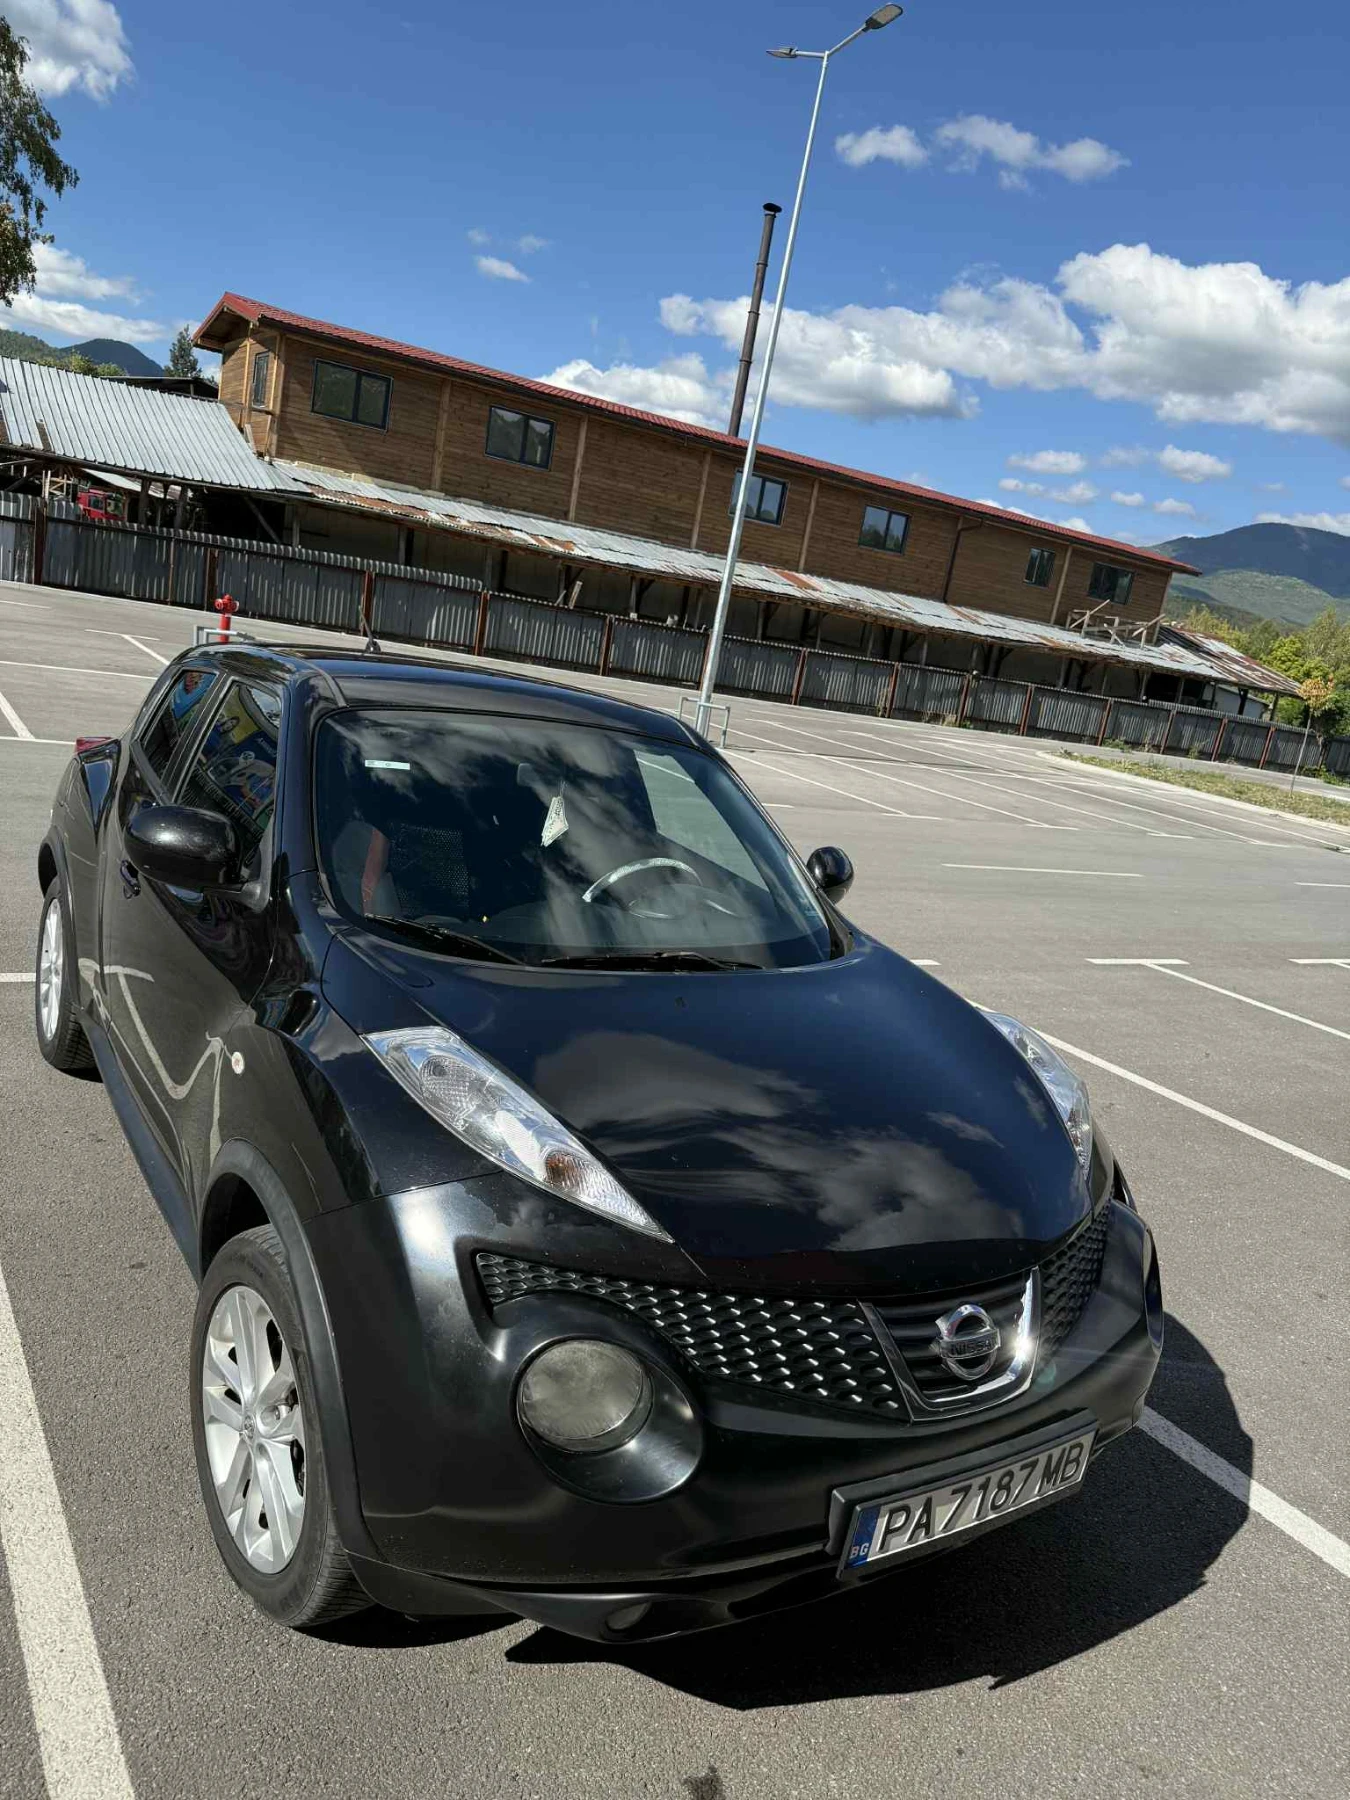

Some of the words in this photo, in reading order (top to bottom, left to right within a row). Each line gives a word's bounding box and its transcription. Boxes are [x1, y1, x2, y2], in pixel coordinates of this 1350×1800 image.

[876, 1496, 932, 1552] PA
[939, 1457, 1040, 1532] 7187
[1034, 1442, 1084, 1494] MB
[849, 1542, 870, 1559] BG
